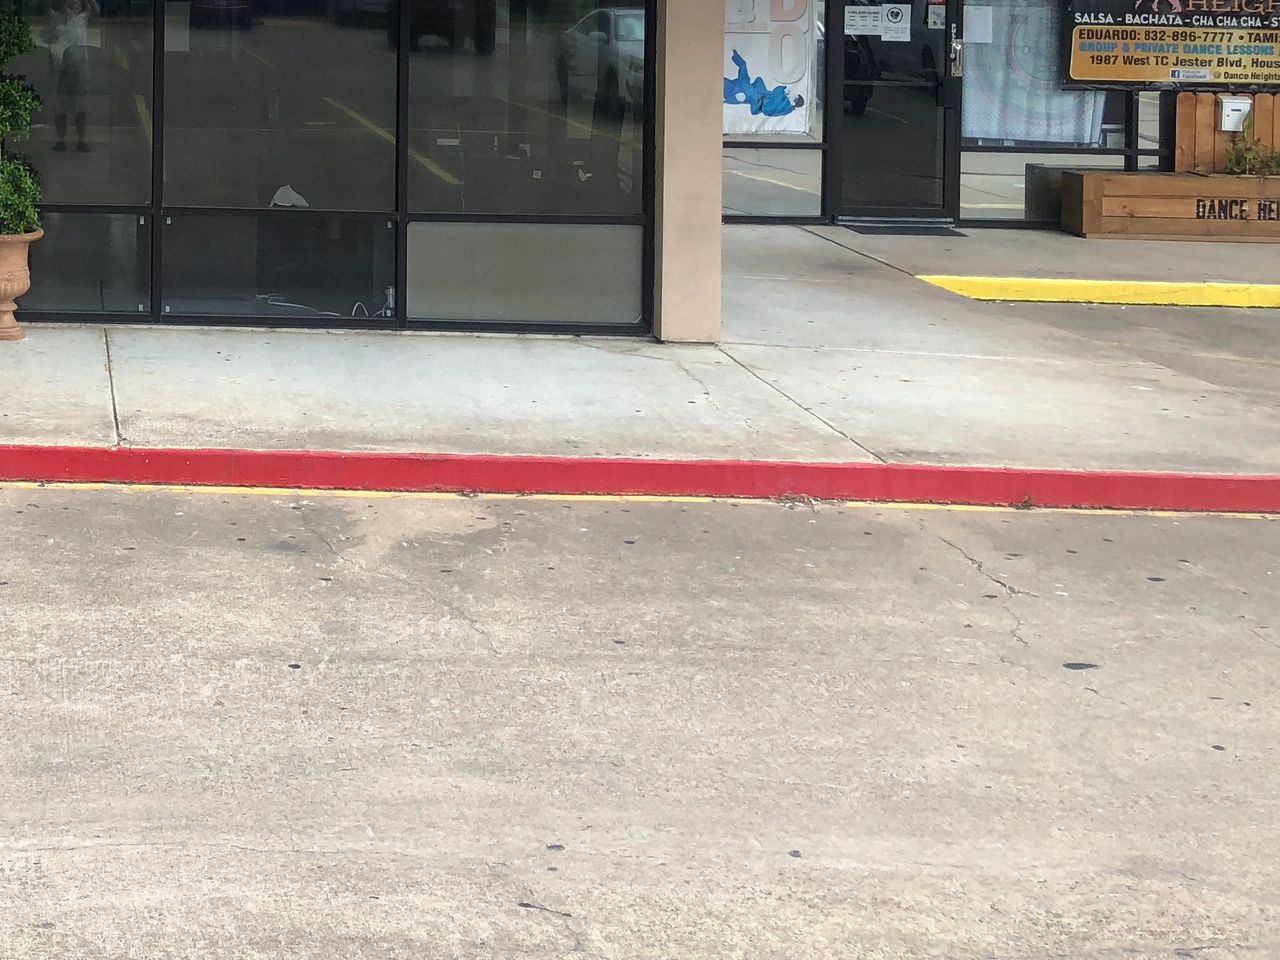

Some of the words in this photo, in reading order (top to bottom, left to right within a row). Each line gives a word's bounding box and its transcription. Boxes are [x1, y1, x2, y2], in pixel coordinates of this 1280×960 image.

[1074, 12, 1113, 24] SALSA
[1125, 13, 1183, 25] BACHATA
[1192, 15, 1214, 26] CHA
[1216, 16, 1238, 27] CHA
[1240, 16, 1262, 27] CHA
[1078, 28, 1141, 41] EDUARDO:
[1144, 30, 1234, 43] 832-896-7777
[1247, 32, 1280, 44] TAMI
[1079, 42, 1118, 54] GROUP
[1134, 43, 1179, 54] PRIVATE
[1183, 44, 1223, 55] DANCE
[1227, 45, 1275, 56] LESSONS
[1089, 55, 1119, 65] 1987
[1122, 56, 1151, 66] West
[1153, 56, 1169, 66] TC
[1172, 57, 1214, 67] Jester
[1217, 57, 1247, 69] Blvd,
[1223, 72, 1249, 80] Dance
[1196, 198, 1249, 220] DANCE
